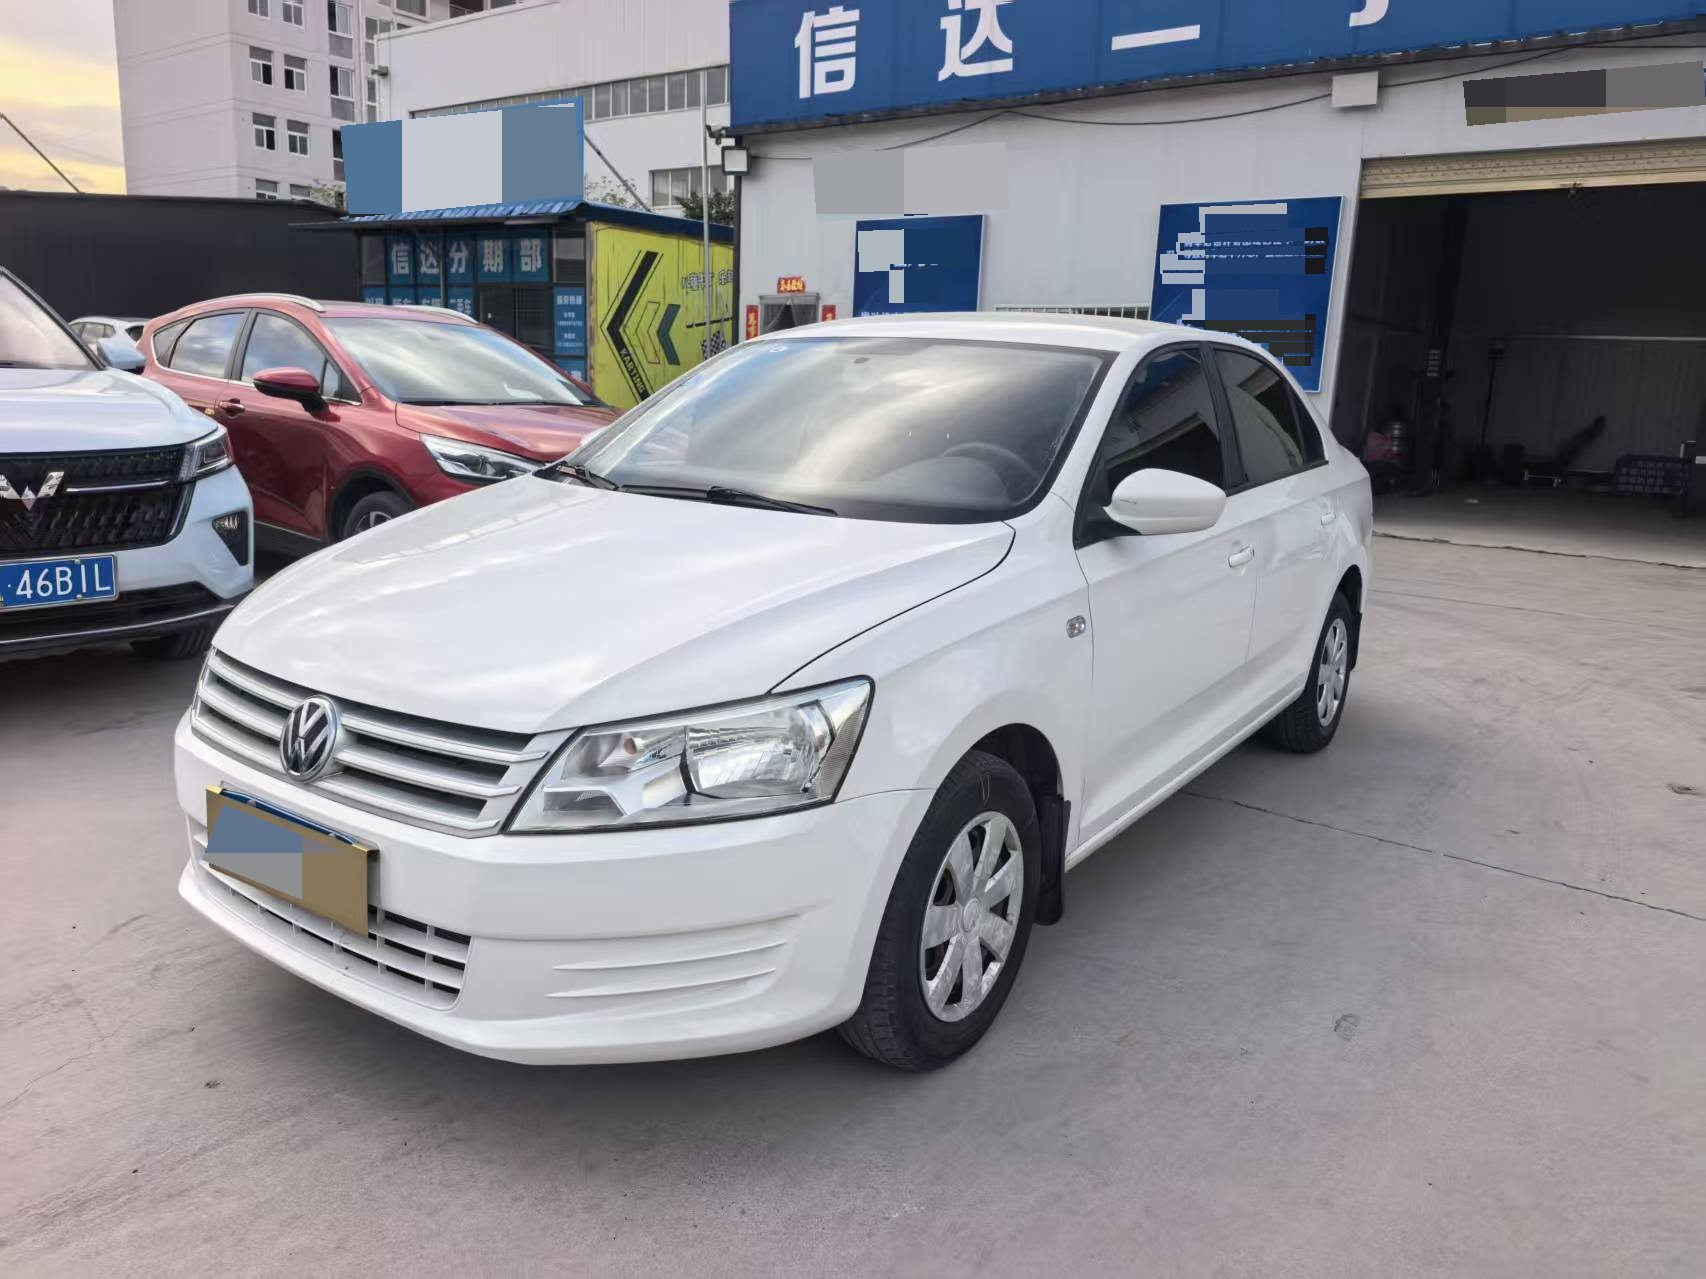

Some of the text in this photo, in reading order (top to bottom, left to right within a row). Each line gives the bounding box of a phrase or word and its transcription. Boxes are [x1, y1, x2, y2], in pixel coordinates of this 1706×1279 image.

[392, 238, 542, 275] 信达分期部
[620, 348, 646, 393] KARTING
